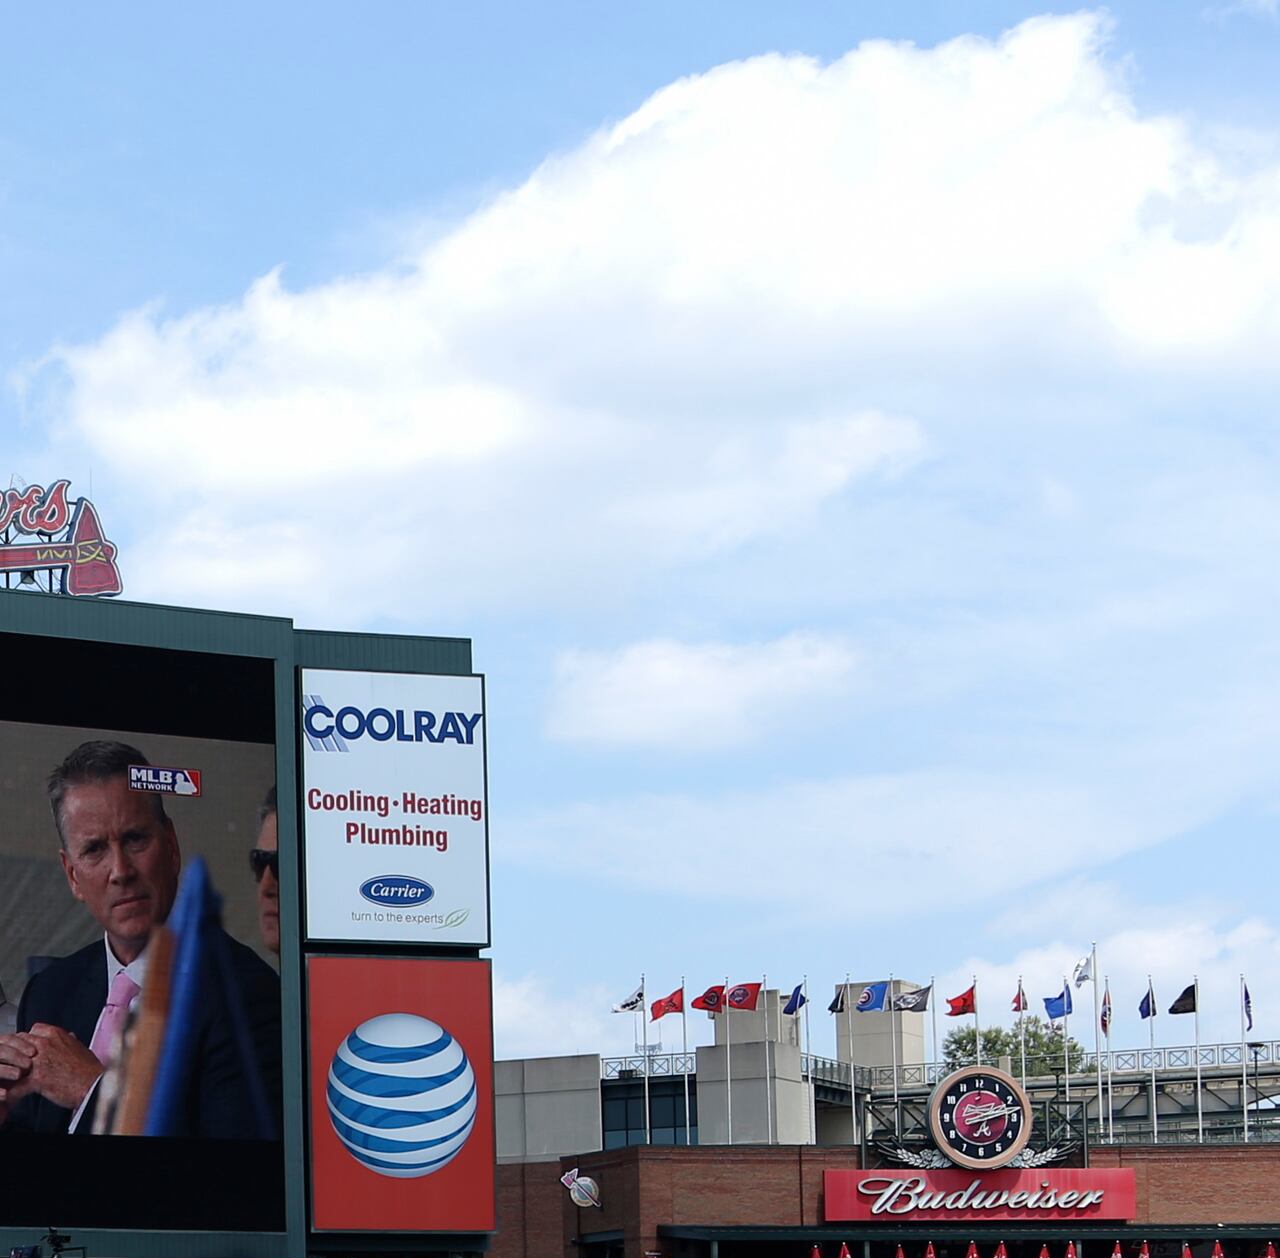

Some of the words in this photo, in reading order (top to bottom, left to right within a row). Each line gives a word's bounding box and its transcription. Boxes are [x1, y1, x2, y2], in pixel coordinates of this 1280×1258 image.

[304, 704, 483, 745] COOLRAY
[130, 767, 173, 784] MLB
[131, 781, 174, 792] NETWORK
[307, 787, 390, 818] Cooling
[402, 792, 482, 822] Heating
[346, 822, 448, 852] Plumbing
[370, 882, 424, 899] Carrier
[351, 911, 372, 922] turn
[373, 911, 384, 922] to
[386, 911, 403, 923] the
[405, 912, 443, 925] experts
[960, 1084, 967, 1092] 11
[975, 1079, 984, 1088] 12
[995, 1084, 999, 1092] 1
[947, 1096, 956, 1104] 10
[1006, 1096, 1013, 1104] 2
[943, 1113, 950, 1122] 9
[1011, 1113, 1017, 1122] 3
[973, 1121, 991, 1136] A
[949, 1130, 955, 1139] 8
[1006, 1130, 1012, 1138] 4
[962, 1143, 967, 1151] 7
[979, 1147, 984, 1156] 6
[995, 1143, 1002, 1152] 5
[857, 1174, 1106, 1215] Budweiser
